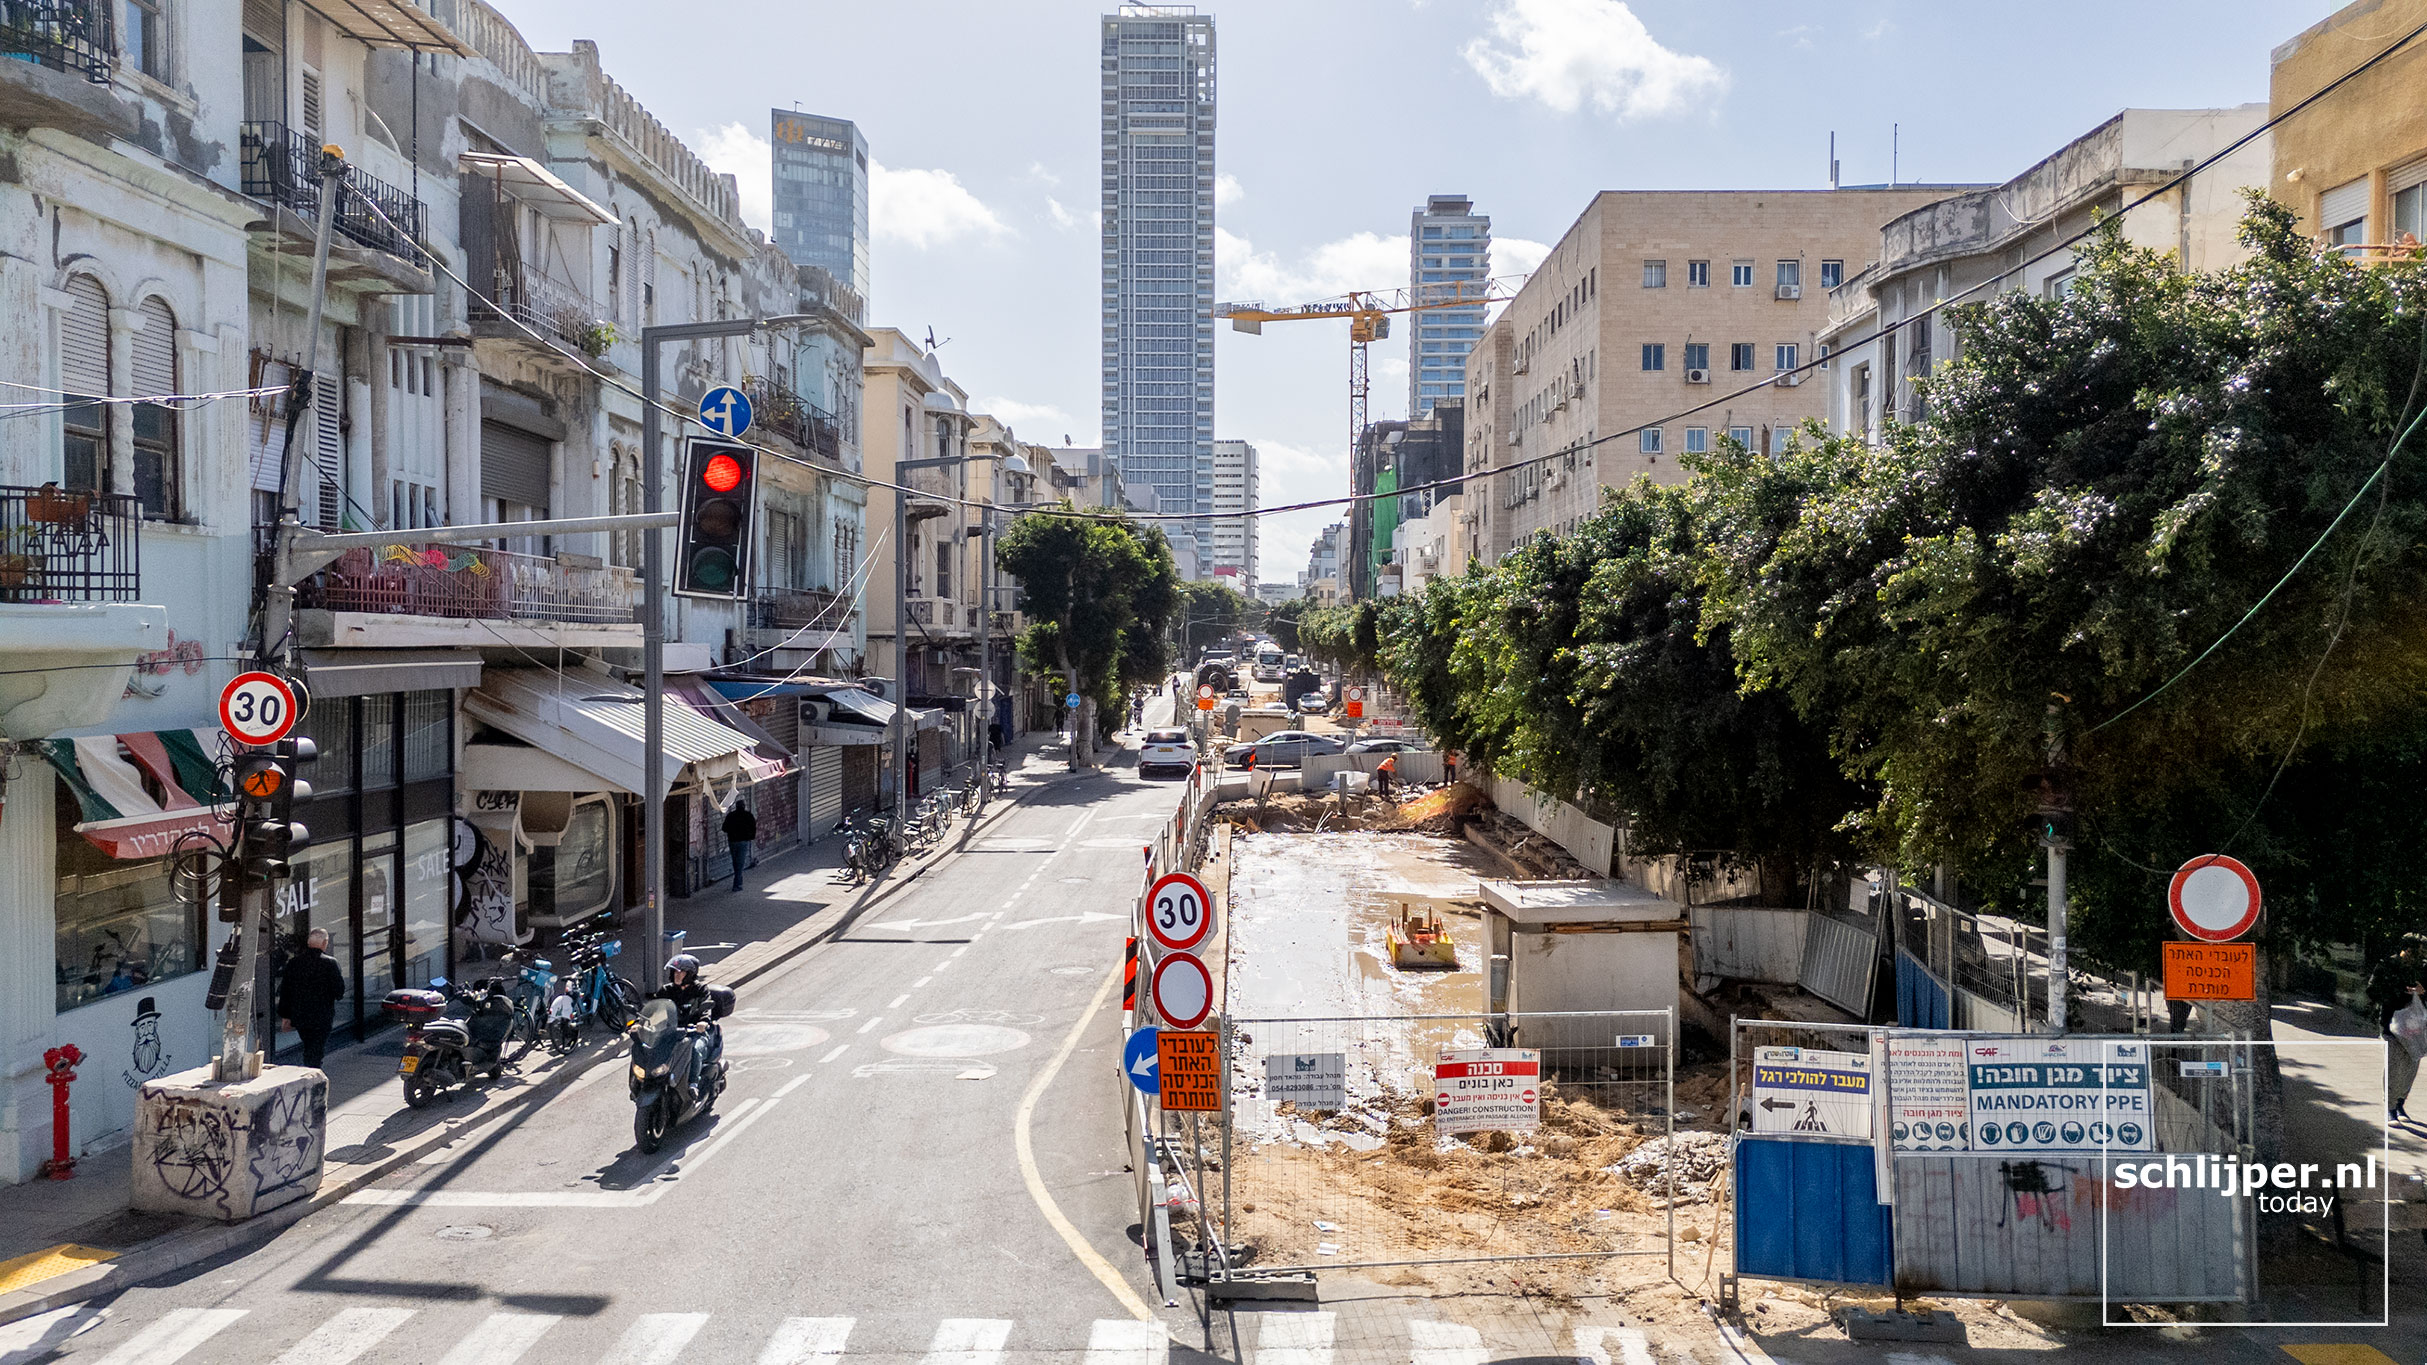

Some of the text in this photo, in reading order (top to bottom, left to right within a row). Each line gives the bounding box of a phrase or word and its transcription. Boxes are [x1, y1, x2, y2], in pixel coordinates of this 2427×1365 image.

[234, 691, 280, 725] 30
[418, 848, 450, 881] SALE
[275, 877, 319, 919] SALE
[1158, 893, 1197, 929] 30
[2168, 949, 2248, 963] לעובדי האתר
[2186, 966, 2230, 978] הכניסה
[2188, 983, 2229, 995] מותרת
[1161, 1036, 1216, 1053] לעובדי
[1168, 1056, 1211, 1071] האתר
[1467, 1063, 1504, 1076] סכנה
[1163, 1073, 1220, 1089] הכניסה
[1759, 1068, 1866, 1089] מעבר להולכי רגל
[1976, 1067, 2140, 1086] ציוד מגן חובה!
[1459, 1079, 1514, 1091] כאן בונים
[1168, 1091, 1218, 1107] מותרת
[1451, 1094, 1472, 1103] מעבר
[1509, 1093, 1521, 1102] אין
[1977, 1095, 2143, 1110] MANDATORY PPE
[1437, 1105, 1537, 1116] DANGER! CONSTRUCTION!
[1903, 1109, 1963, 1119] ציוד מגן חובה
